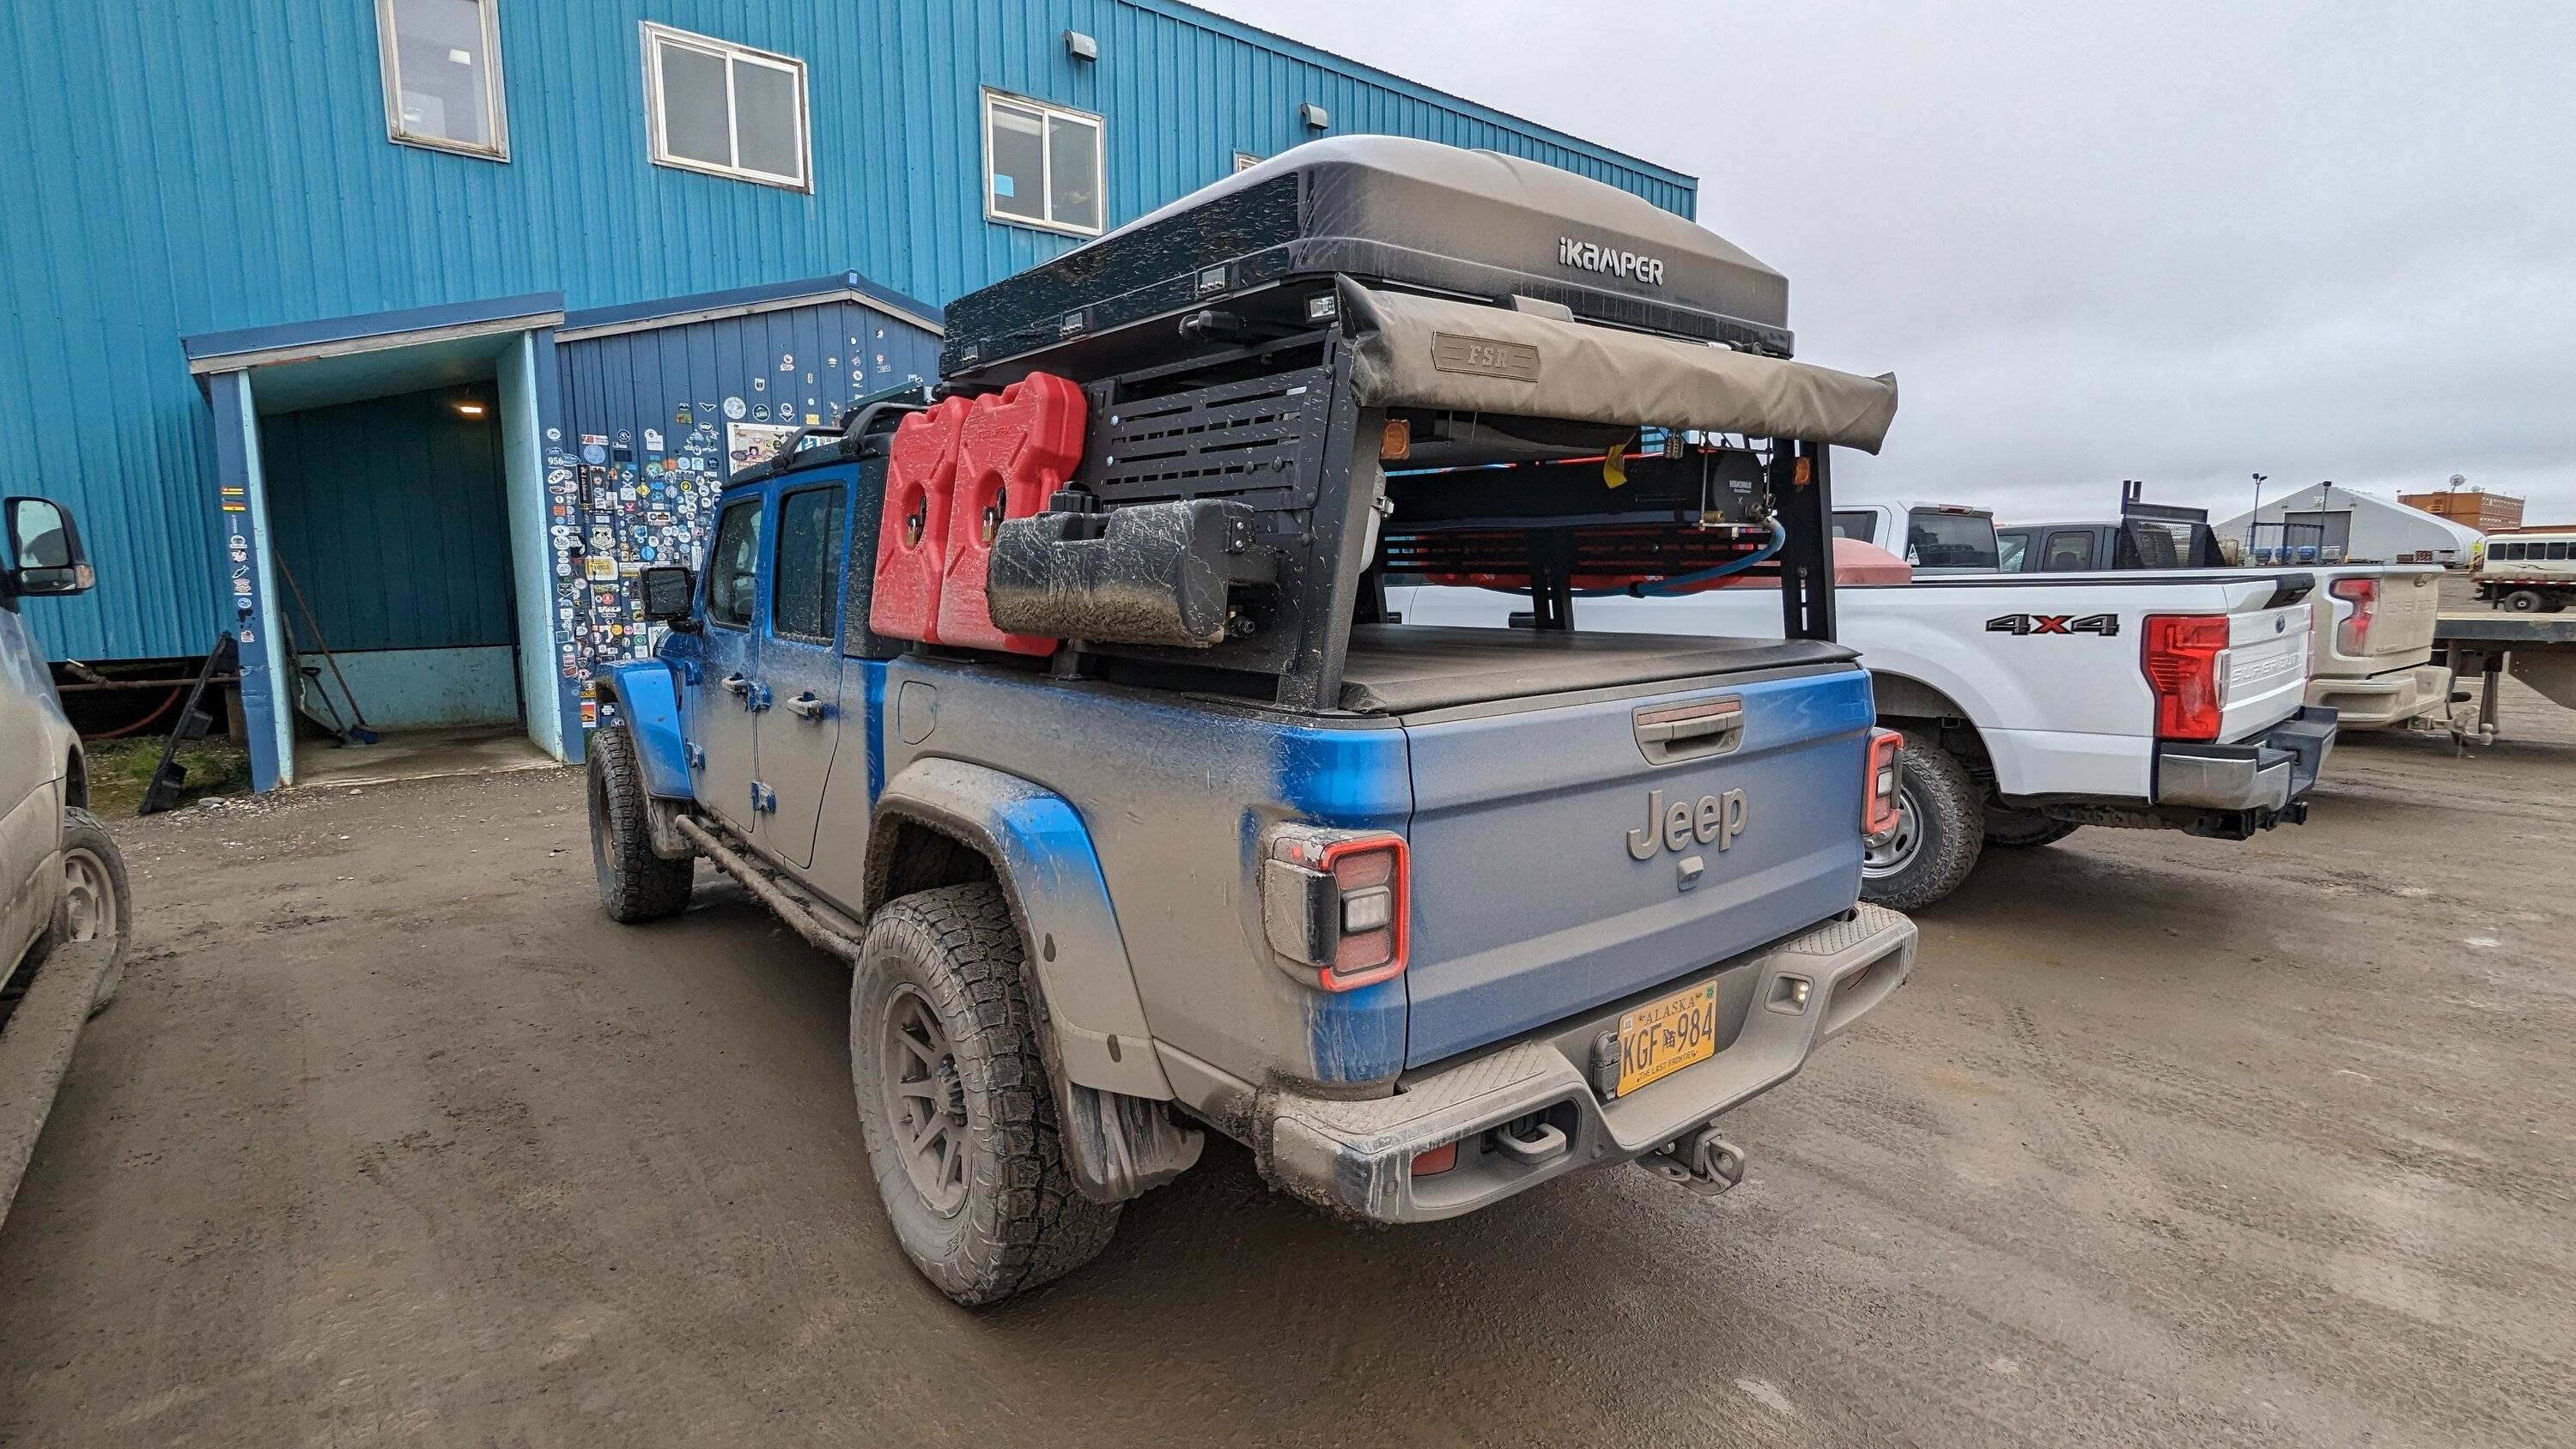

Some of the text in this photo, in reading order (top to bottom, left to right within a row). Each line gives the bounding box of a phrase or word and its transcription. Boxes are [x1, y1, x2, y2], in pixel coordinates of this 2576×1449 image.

[1467, 344, 1509, 369] FSR
[548, 457, 563, 465] 956
[2231, 659, 2277, 682] SUPER
[1627, 788, 1748, 860] Jeep
[1644, 996, 1696, 1025] ALASKA
[1623, 1002, 1713, 1078] KGF 984
[1640, 1050, 1697, 1079] THE LAST FRONTIER
